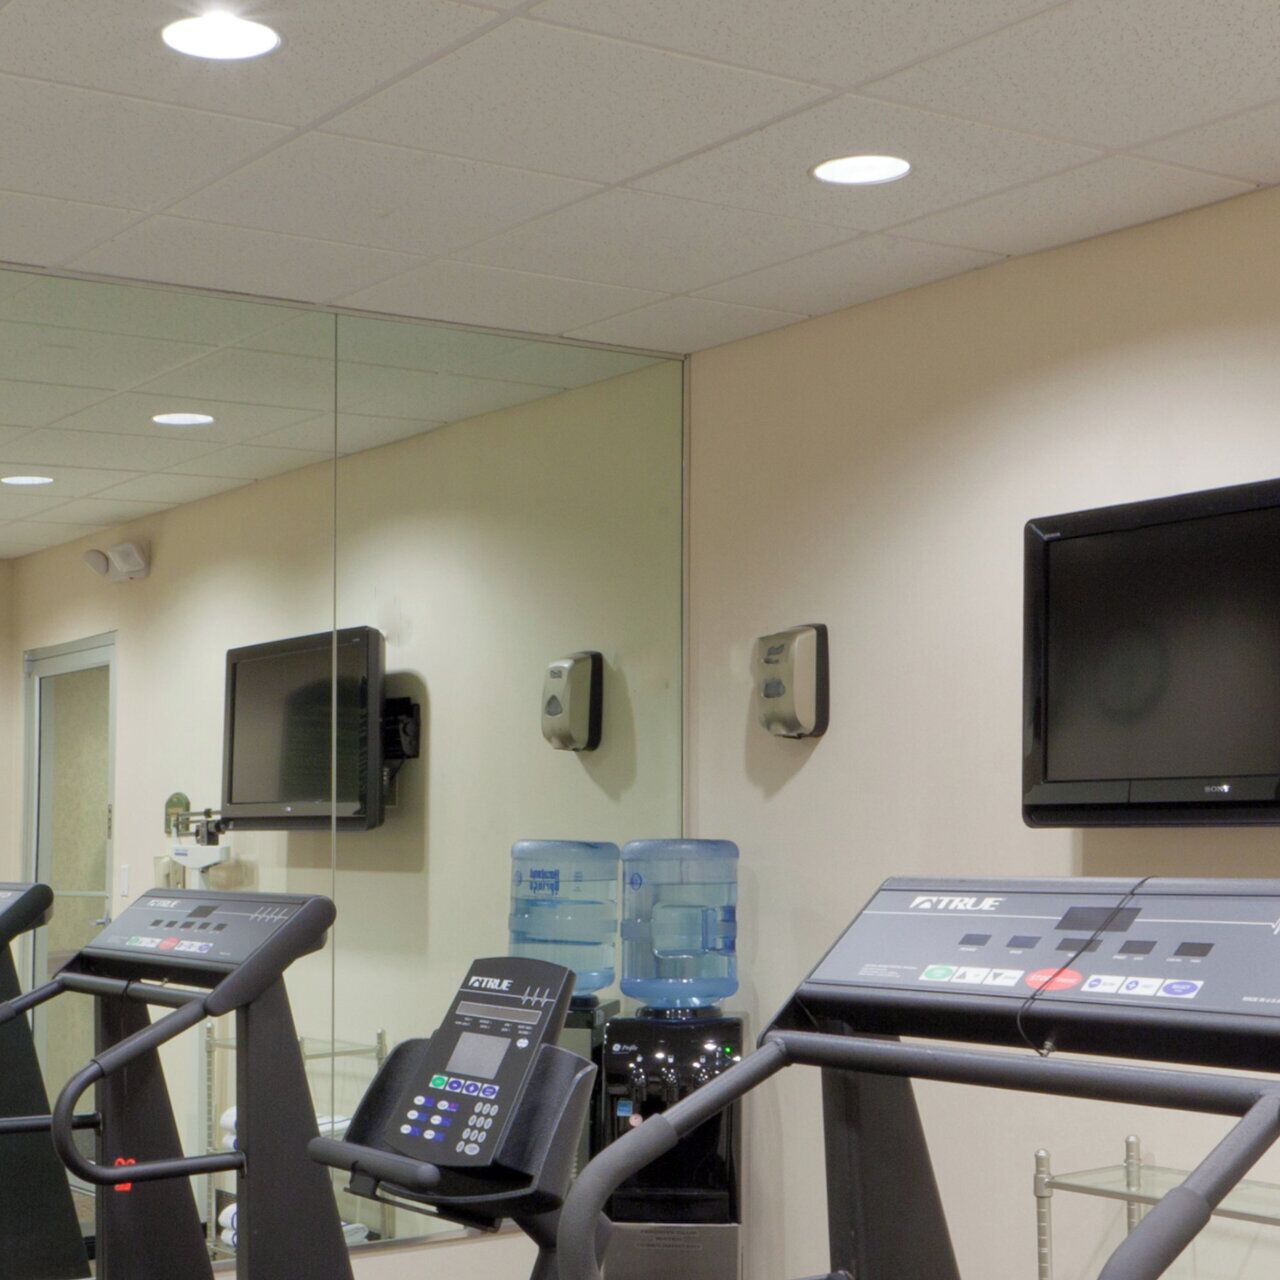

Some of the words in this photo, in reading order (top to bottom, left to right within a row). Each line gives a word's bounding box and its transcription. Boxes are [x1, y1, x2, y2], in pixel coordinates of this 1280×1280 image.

[1204, 785, 1231, 793] SONY
[937, 897, 1006, 910] TRUE
[479, 978, 513, 991] TRUE
